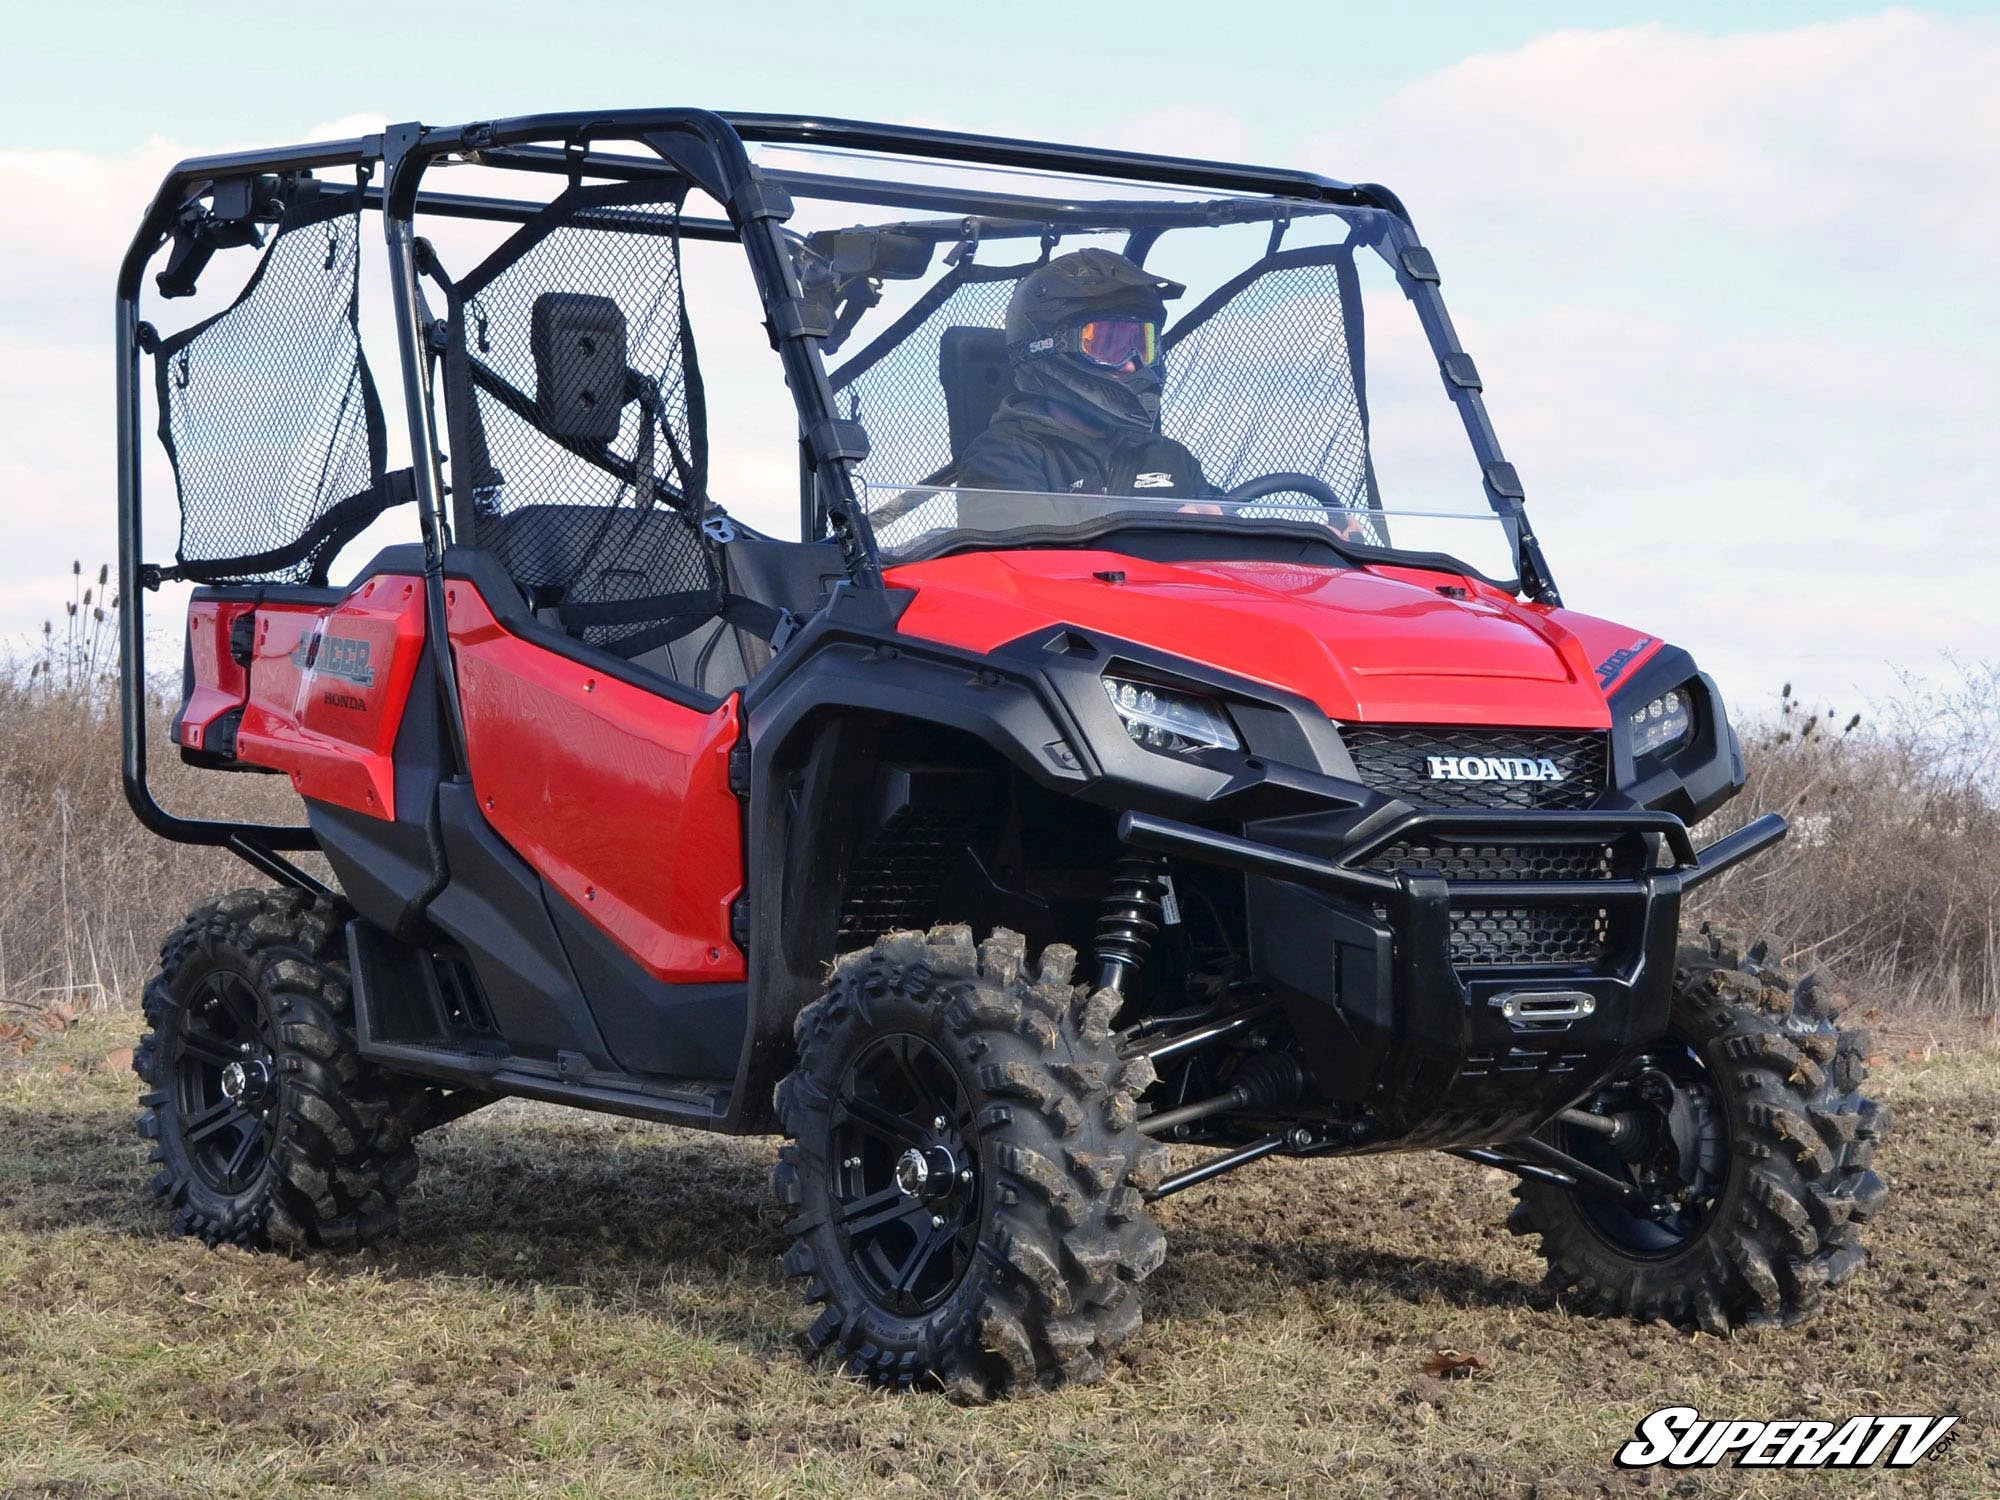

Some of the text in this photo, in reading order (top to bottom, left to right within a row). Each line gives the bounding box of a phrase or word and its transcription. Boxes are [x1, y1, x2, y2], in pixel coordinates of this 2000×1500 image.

[1029, 337, 1054, 353] 509
[323, 691, 367, 712] HONDA
[1427, 756, 1564, 781] HONDA
